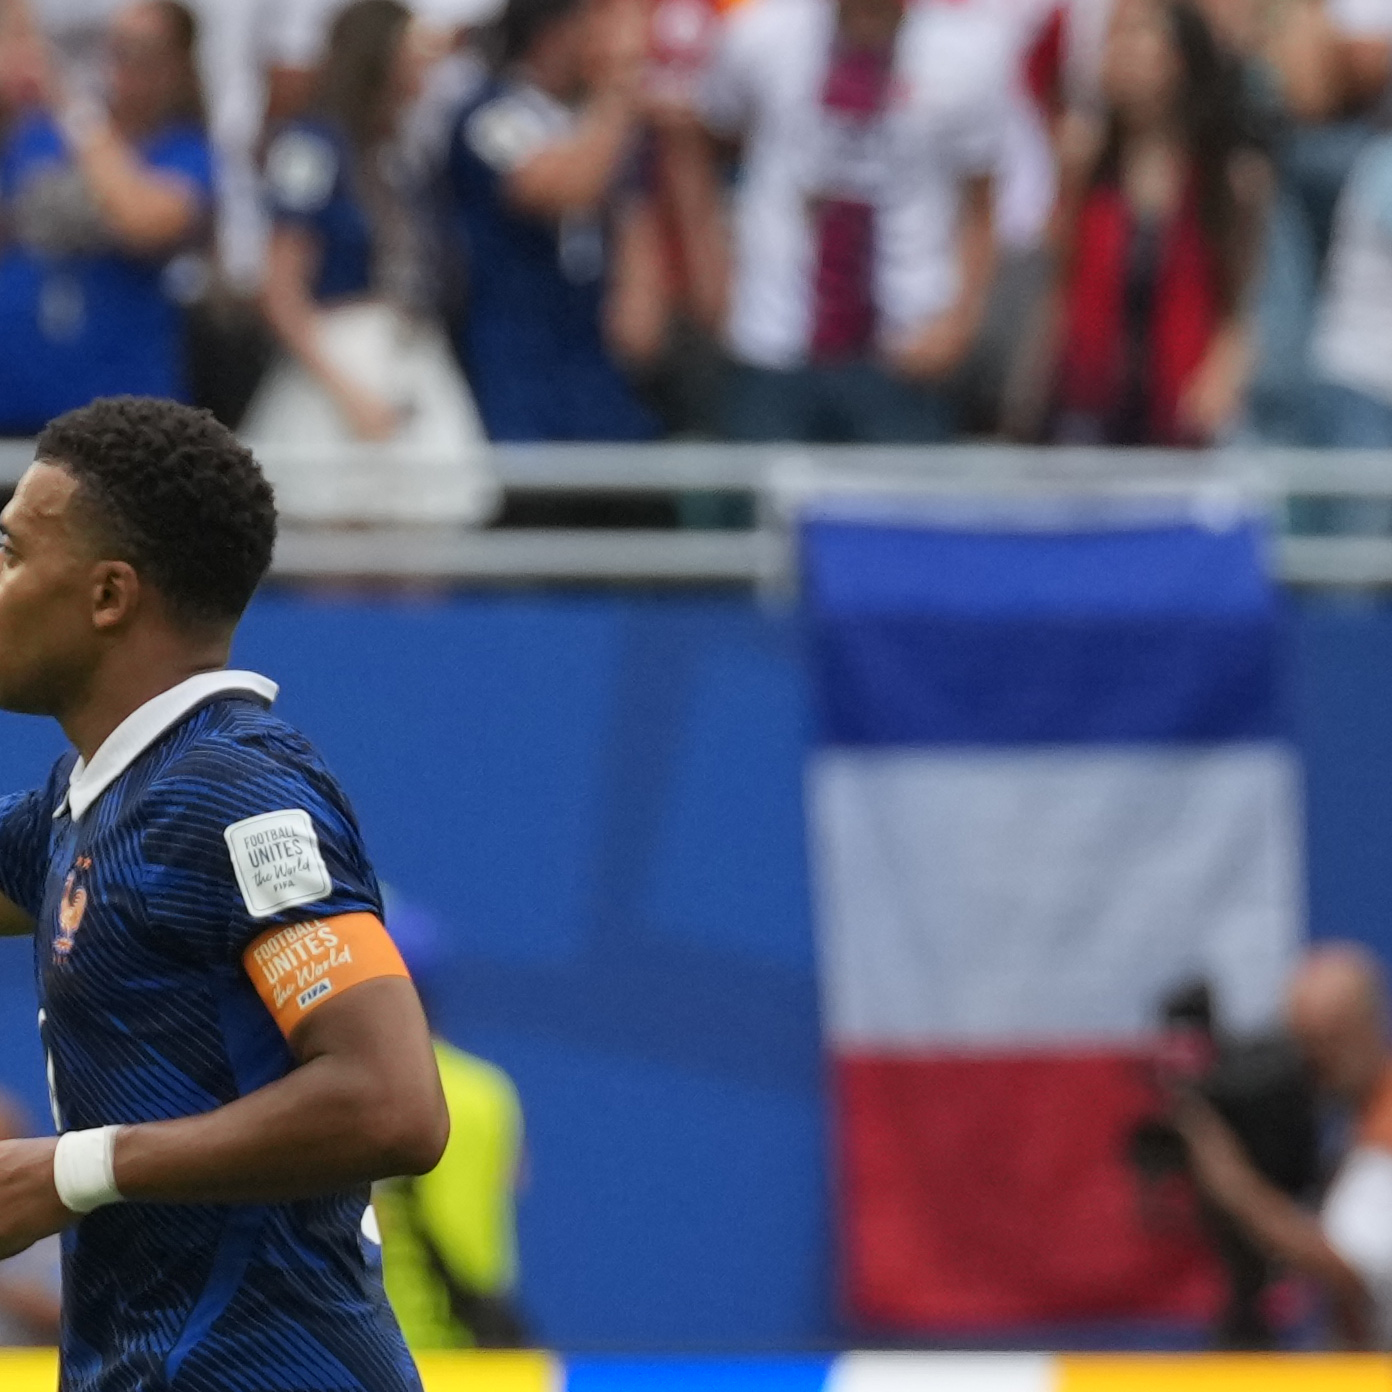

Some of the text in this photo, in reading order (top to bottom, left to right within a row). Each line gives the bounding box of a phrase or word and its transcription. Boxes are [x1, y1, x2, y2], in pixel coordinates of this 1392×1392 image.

[243, 825, 299, 849] FOOTBALL
[247, 838, 303, 868] UNITES
[251, 855, 311, 888] the World
[273, 880, 296, 893] FIFA
[253, 919, 326, 966] FOOTBALL
[261, 926, 339, 985] UNITES
[272, 943, 353, 1011] the World
[299, 981, 329, 1006] FIFA
